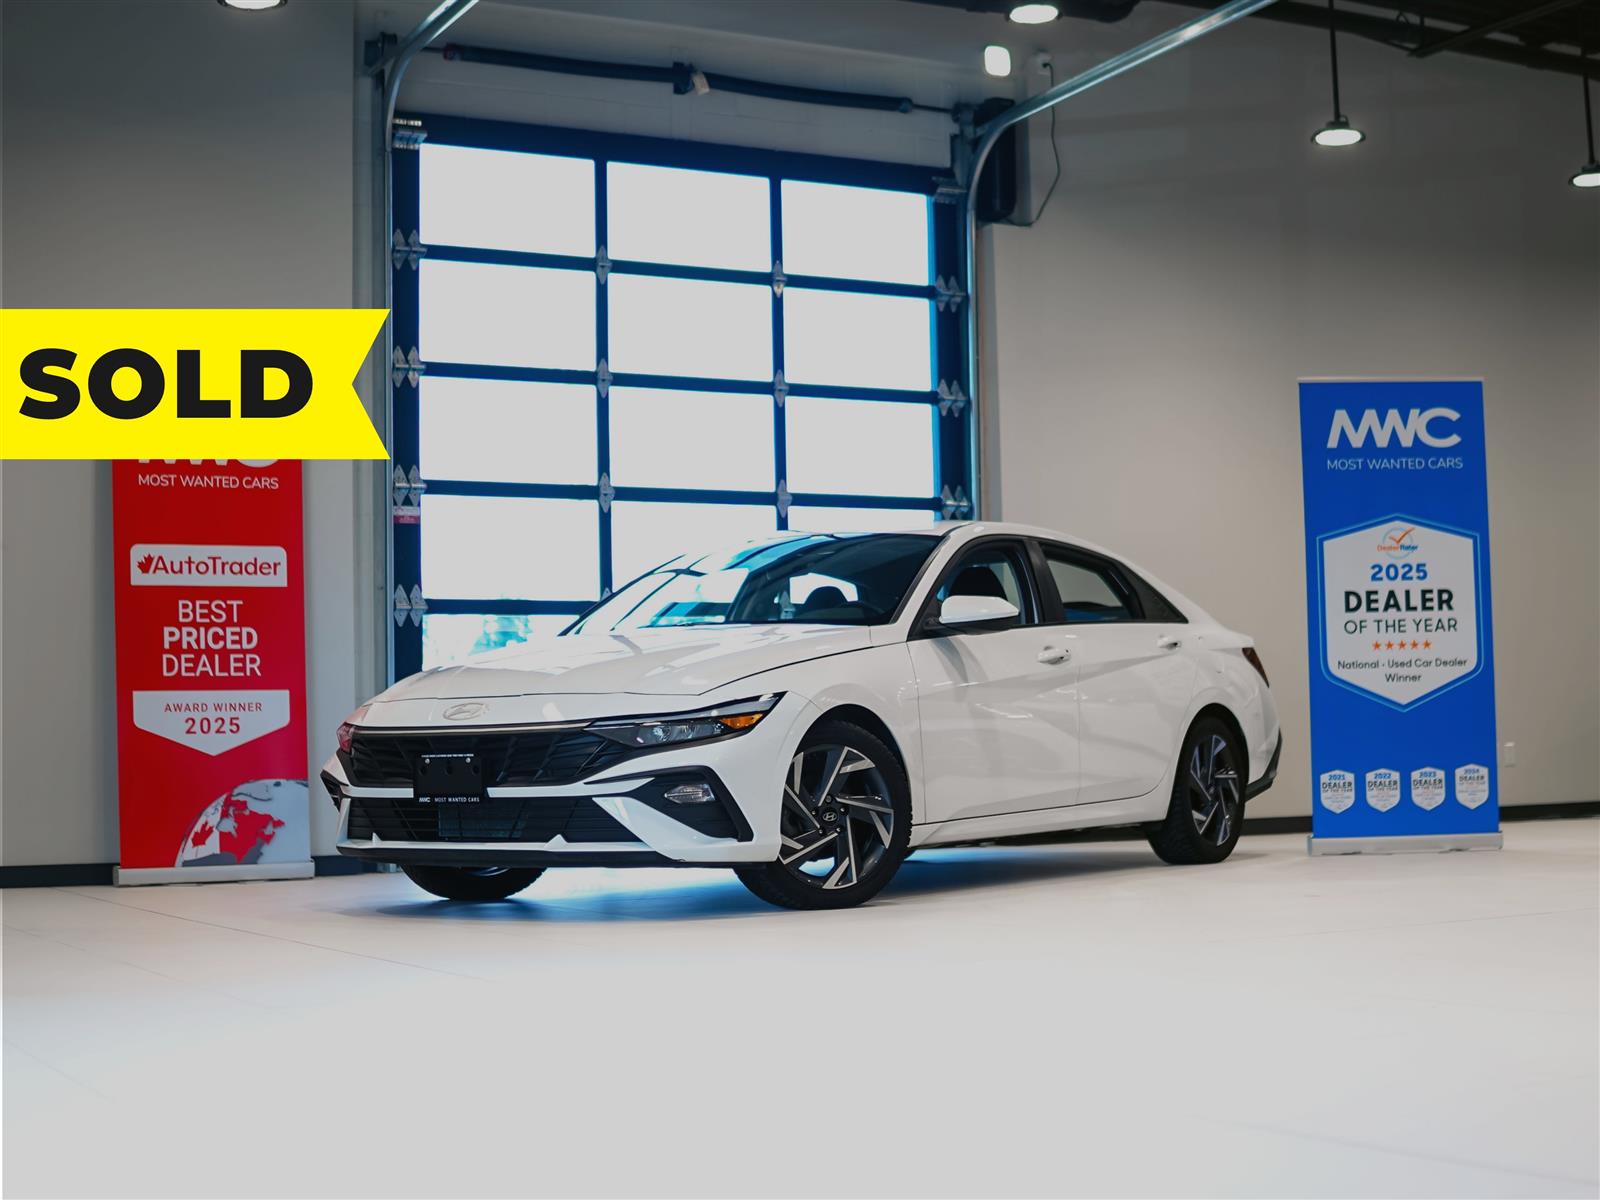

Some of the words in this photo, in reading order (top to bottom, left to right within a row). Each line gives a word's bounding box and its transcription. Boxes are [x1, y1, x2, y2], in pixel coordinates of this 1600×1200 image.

[1326, 407, 1462, 449] MWC
[1327, 458, 1364, 471] MOST
[1367, 458, 1425, 470] WANTED
[1428, 457, 1463, 469] CARS
[138, 474, 177, 487] MOST
[180, 475, 240, 488] WANTED
[243, 477, 279, 489] CARS
[152, 555, 281, 576] AutoTrader
[1370, 563, 1428, 582] 2025
[1344, 589, 1454, 613] DEALER
[178, 600, 243, 623] BEST
[1344, 620, 1367, 635] OF
[1373, 619, 1407, 634] THE
[1412, 618, 1458, 633] YEAR
[163, 627, 258, 650] PRICED
[162, 654, 262, 677] DEALER
[1337, 660, 1379, 670] National
[1387, 658, 1412, 669] Used
[1414, 659, 1432, 668] Car
[1435, 657, 1467, 668] Dealer
[1385, 673, 1421, 682] Winner
[164, 703, 208, 713] AWARD
[213, 702, 263, 713] WINNER
[185, 717, 241, 735] 2025
[1322, 781, 1353, 789] DEALER
[1368, 780, 1398, 788] DEALER
[1412, 779, 1443, 787] DEALER
